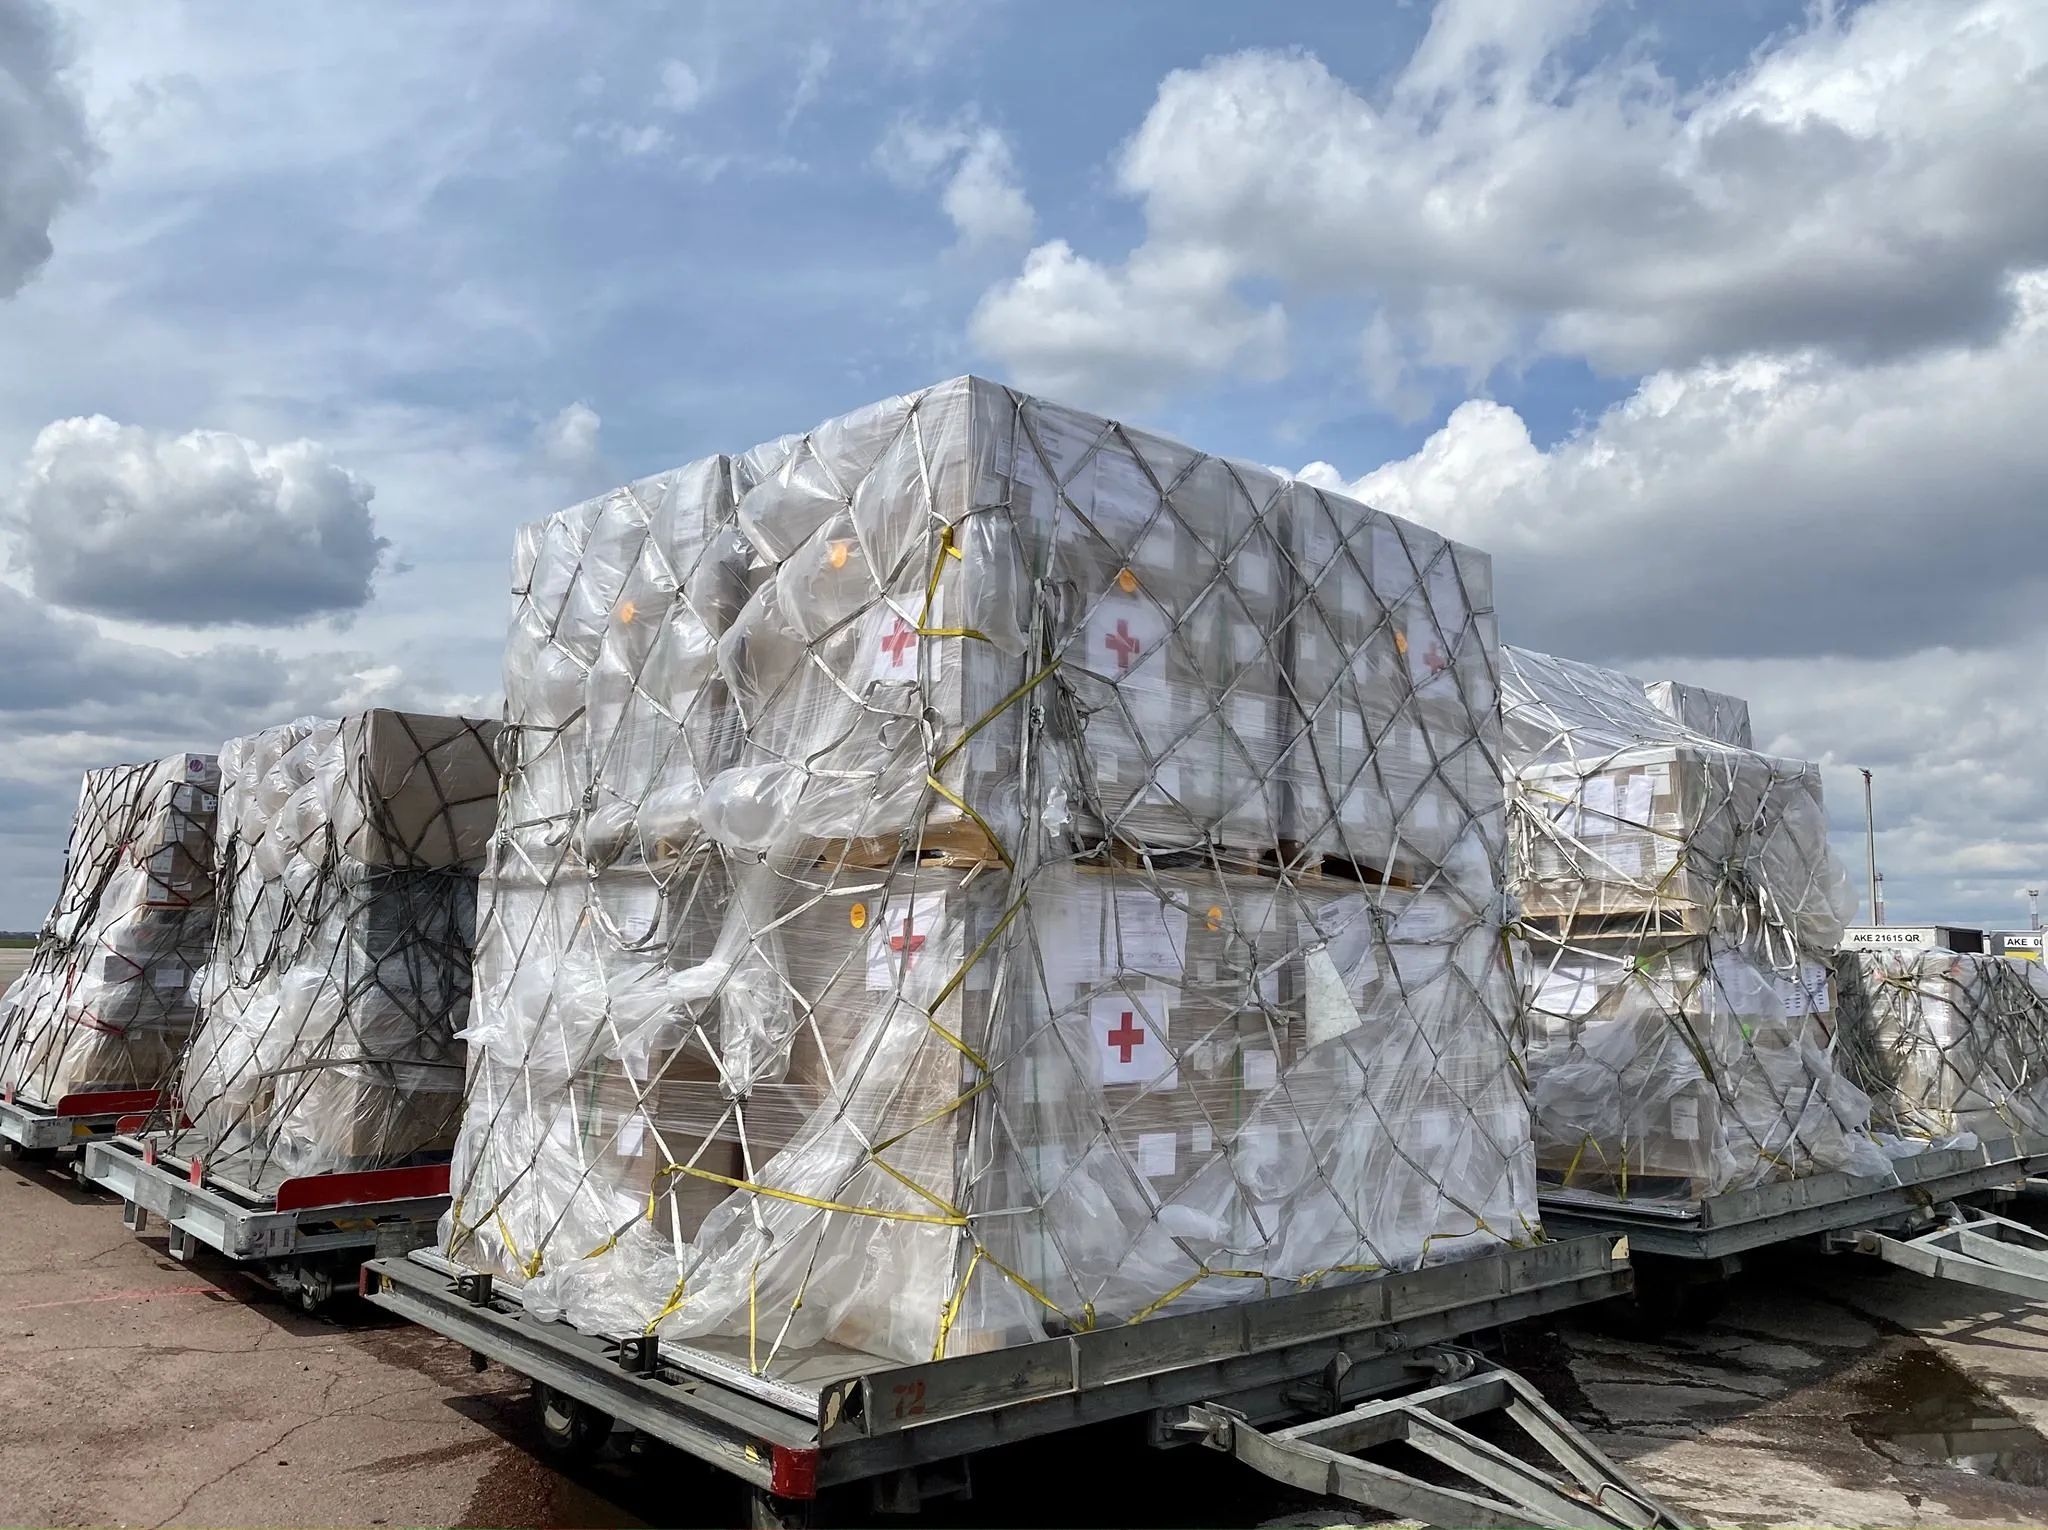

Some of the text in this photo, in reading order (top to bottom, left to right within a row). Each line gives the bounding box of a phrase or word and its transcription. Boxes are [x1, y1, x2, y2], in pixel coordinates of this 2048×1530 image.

[1853, 934, 1920, 942] AKE 21615 QR
[2007, 938, 2028, 946] AKE
[891, 1378, 927, 1418] 72
